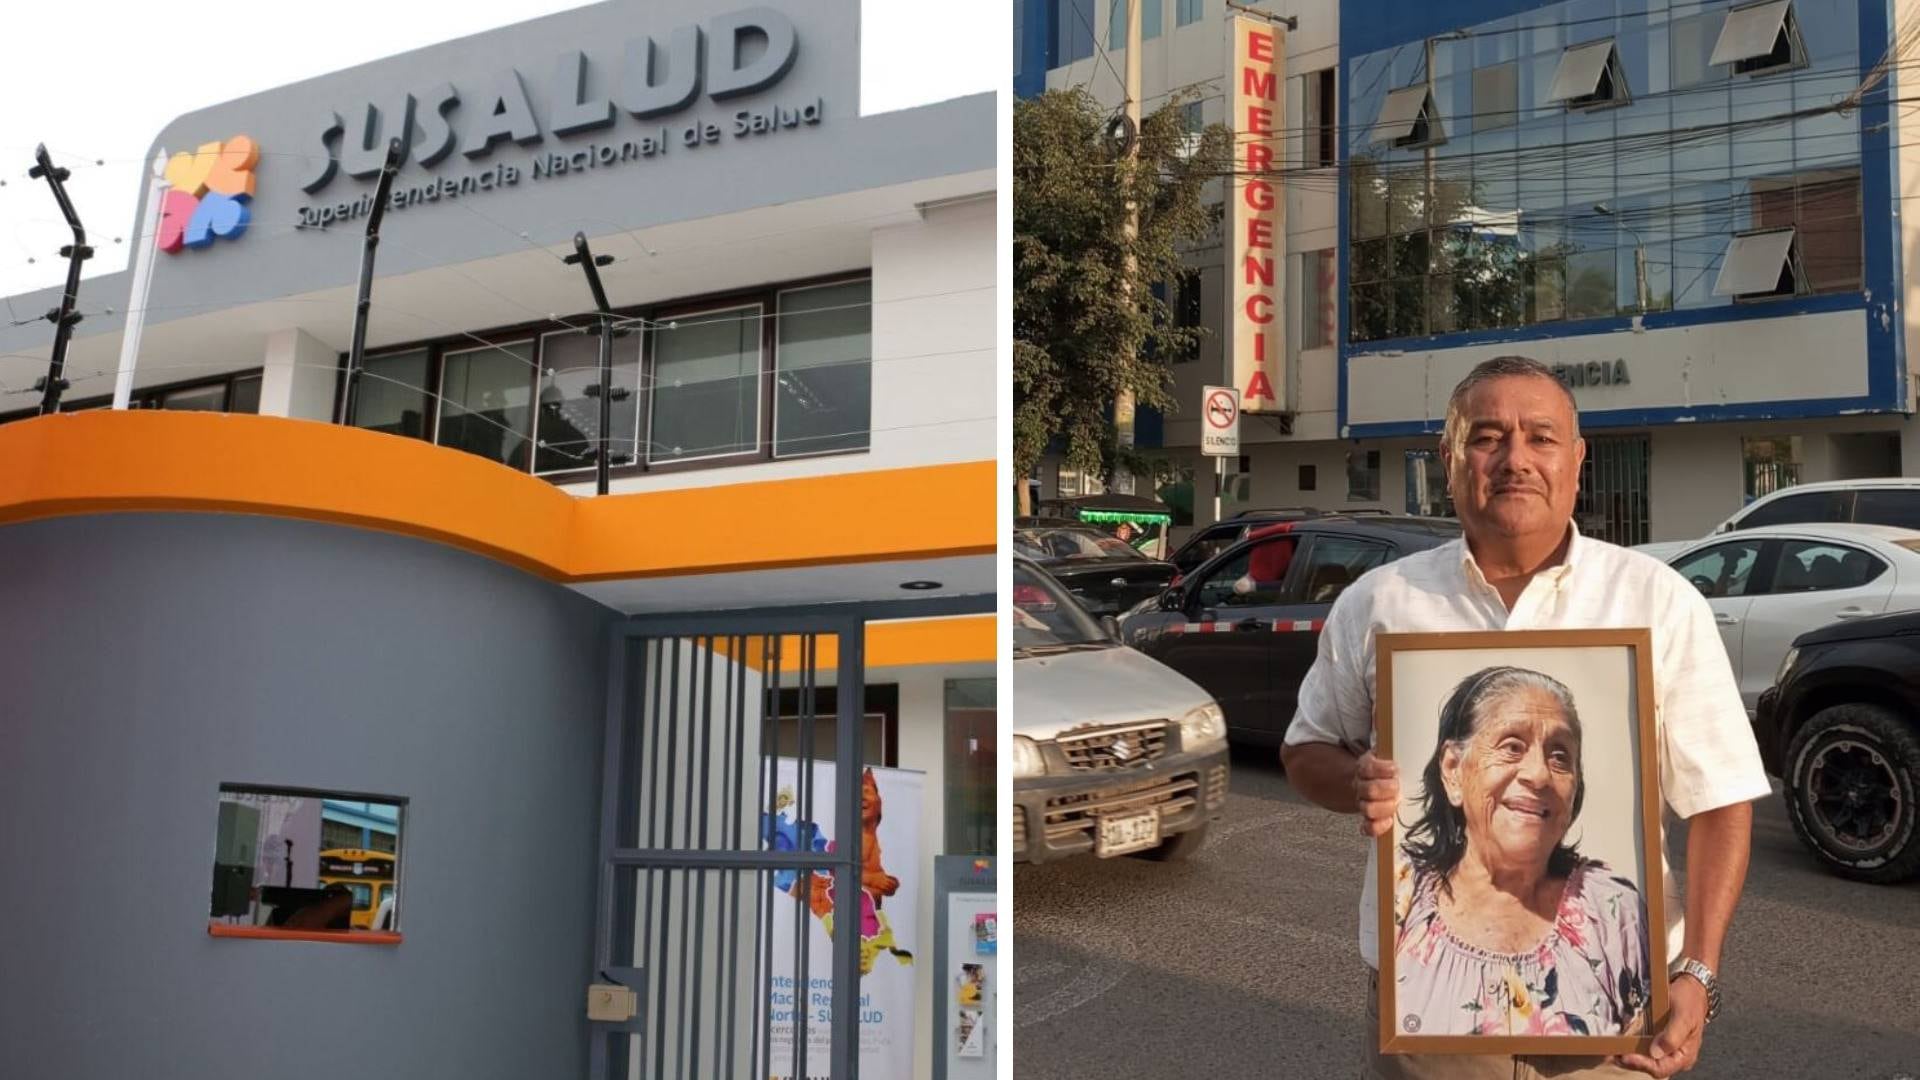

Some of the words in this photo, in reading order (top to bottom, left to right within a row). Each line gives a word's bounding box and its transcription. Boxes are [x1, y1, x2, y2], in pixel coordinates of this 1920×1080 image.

[302, 6, 800, 195] SUSALUD
[532, 126, 668, 179] Nacional
[683, 119, 721, 146] de
[733, 97, 823, 138] Salud
[1242, 31, 1277, 401] EMERGENCIA
[1554, 357, 1632, 388] ENCIA
